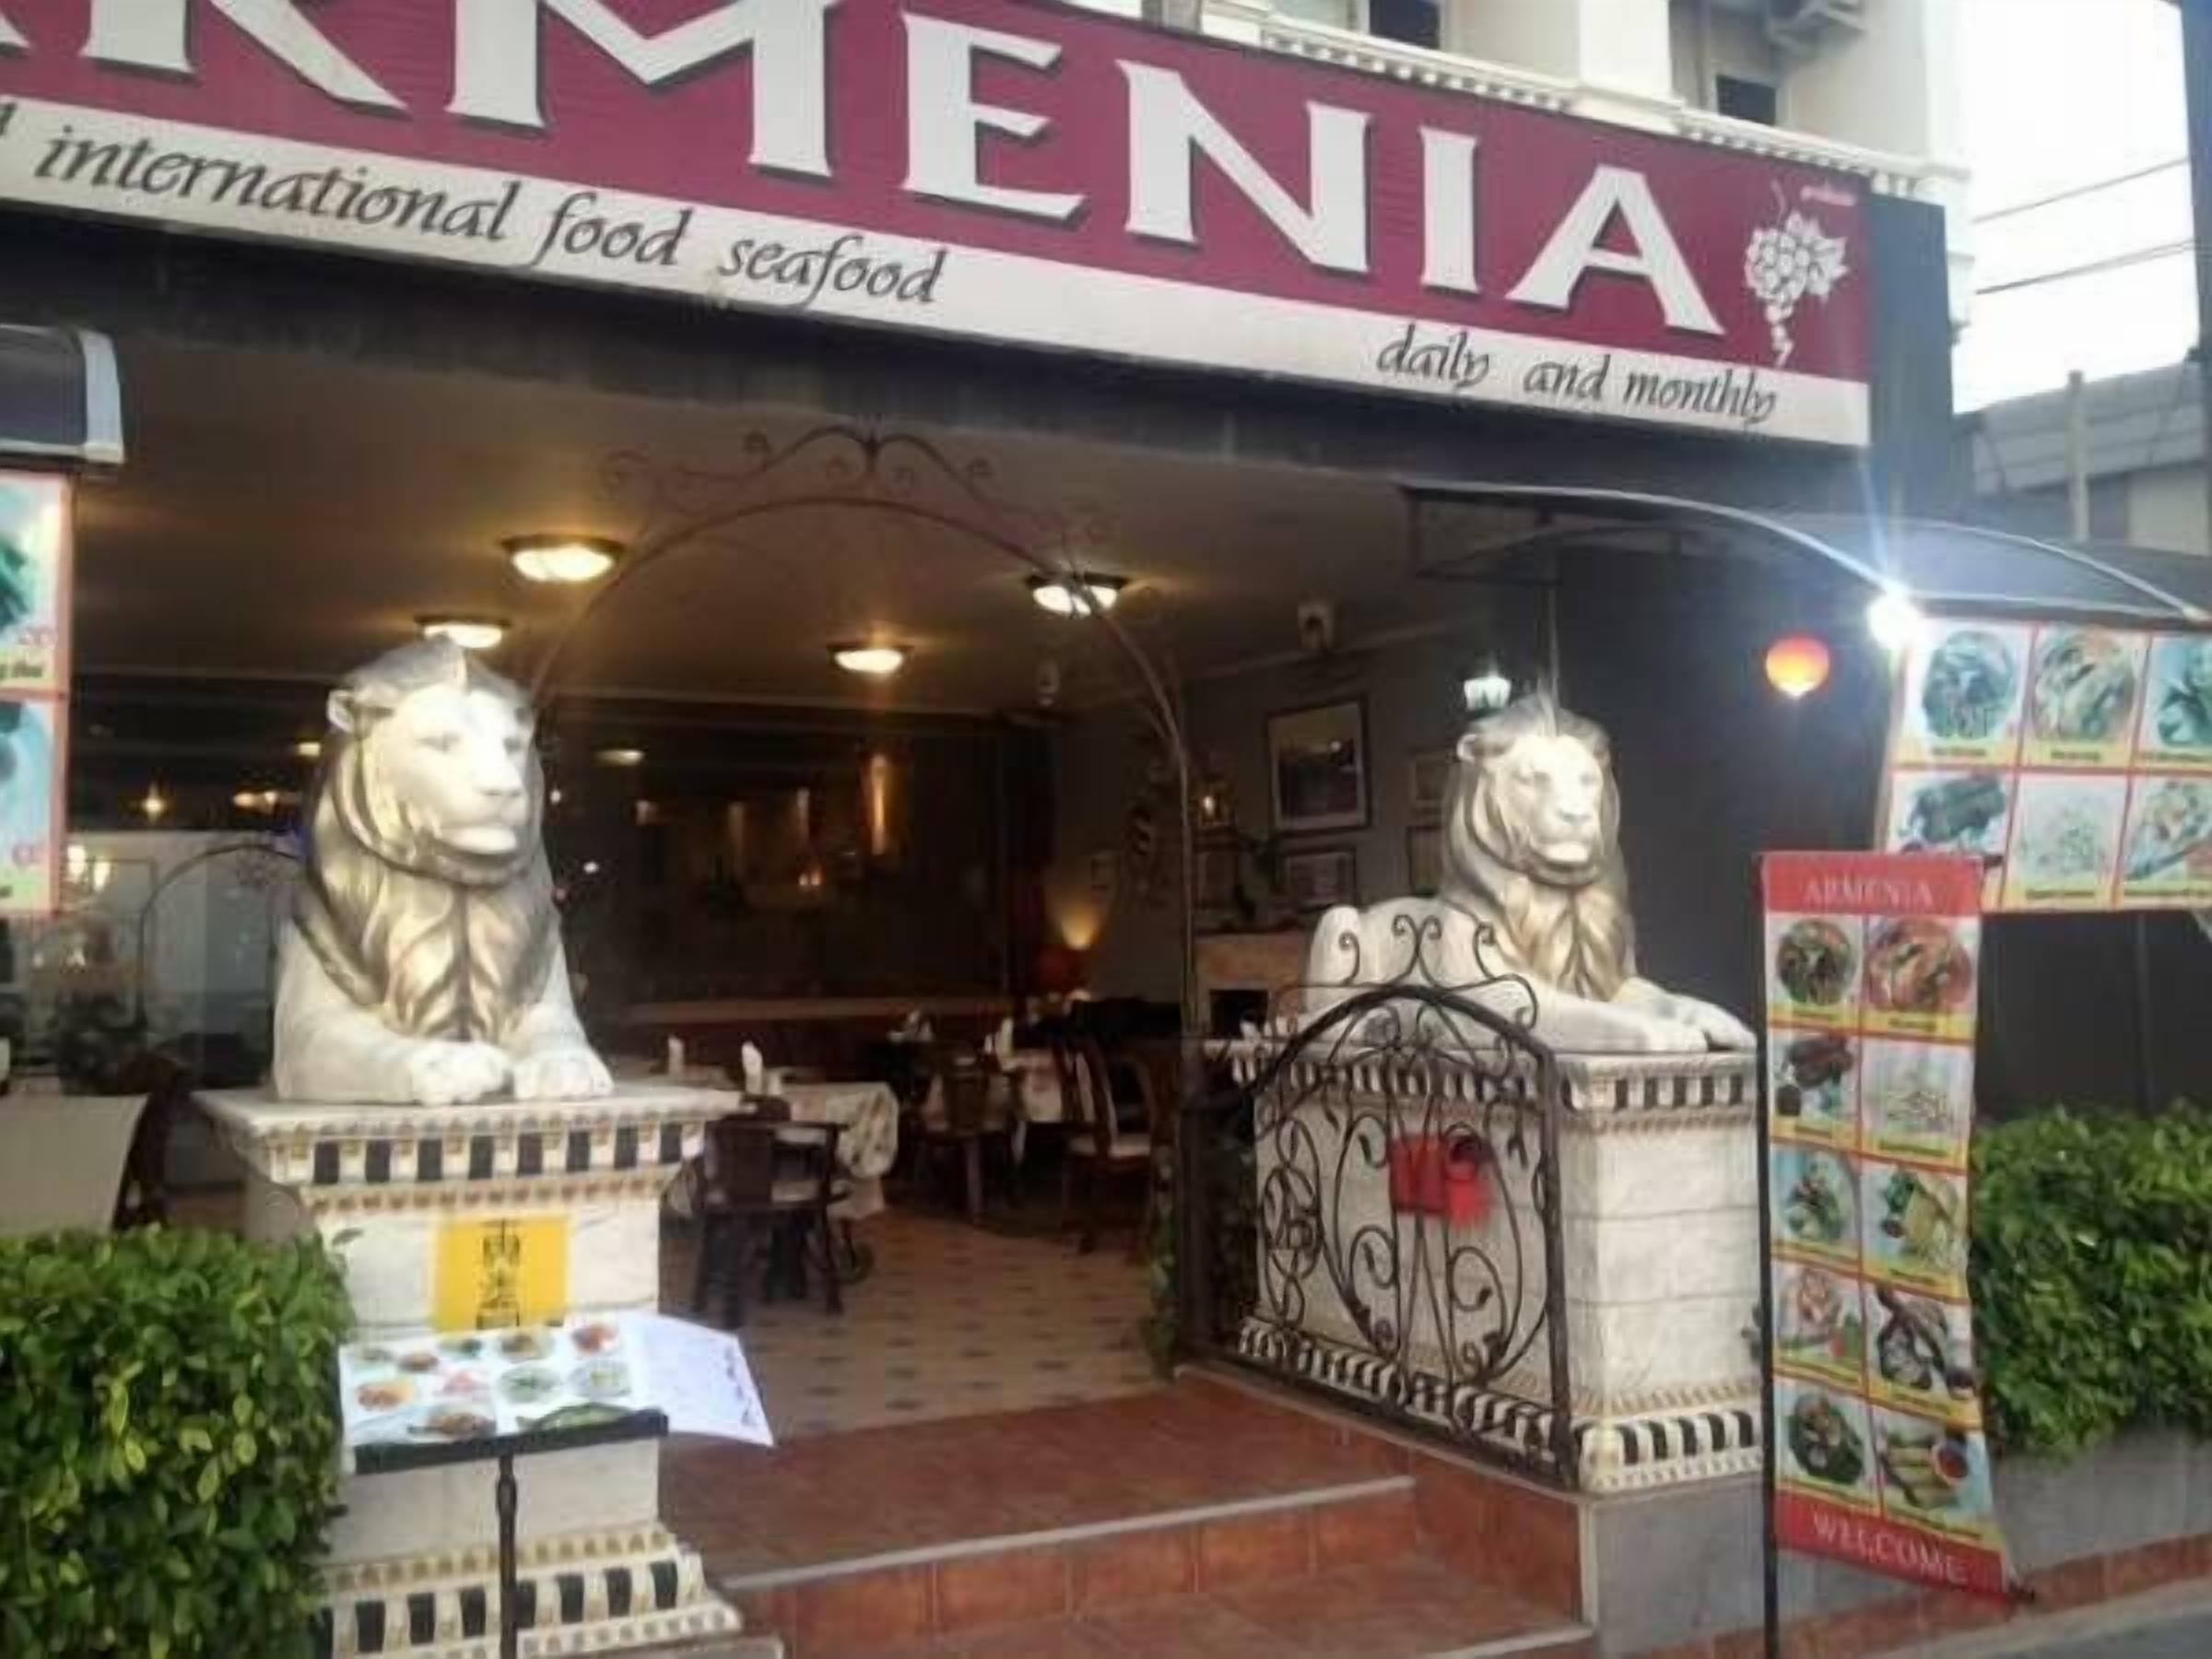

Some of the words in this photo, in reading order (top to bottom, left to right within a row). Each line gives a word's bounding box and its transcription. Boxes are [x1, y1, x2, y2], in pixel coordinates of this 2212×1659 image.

[0, 0, 1725, 335] MENIA
[34, 124, 520, 242] international
[527, 192, 692, 267] food
[720, 232, 947, 312] seafood
[1375, 323, 1489, 389] daily
[1523, 353, 1611, 402] and
[1622, 368, 1777, 425] monthly
[1812, 1510, 1969, 1584] WELCOME
